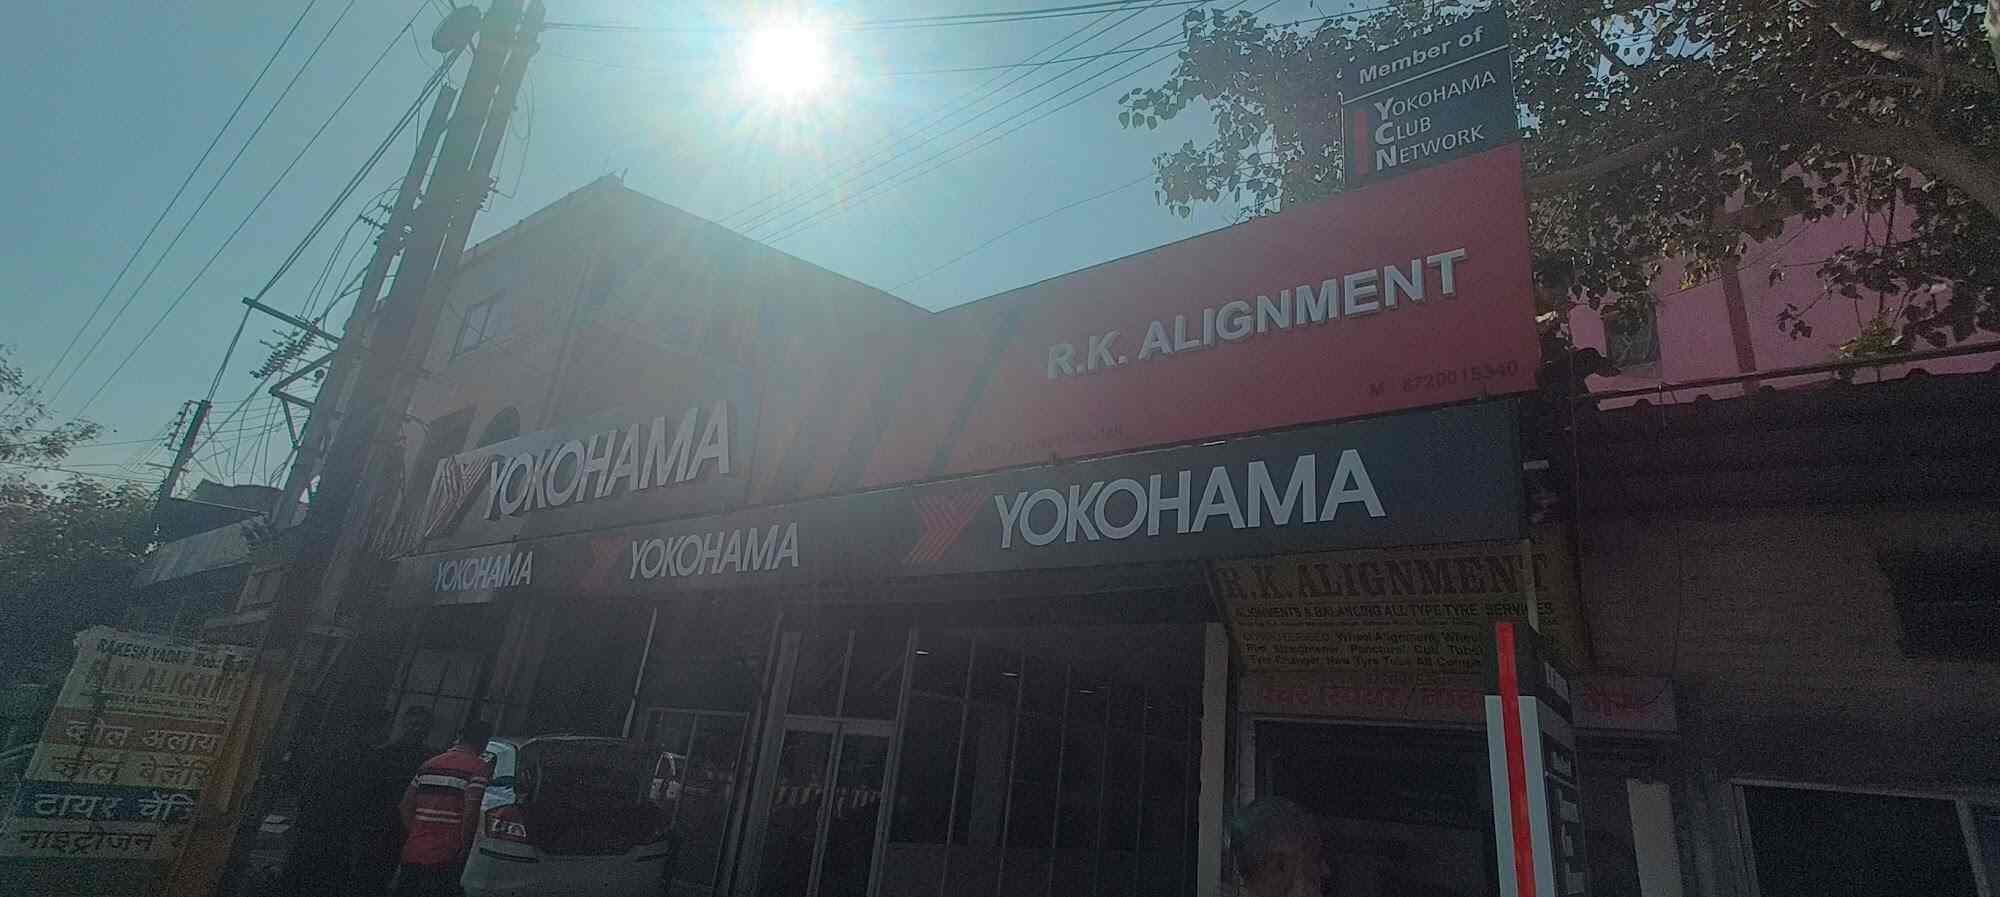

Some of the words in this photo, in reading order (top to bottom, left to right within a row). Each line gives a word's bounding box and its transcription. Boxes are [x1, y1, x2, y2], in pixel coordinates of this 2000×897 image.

[1359, 40, 1451, 84] Member
[1458, 25, 1484, 48] of
[1374, 70, 1497, 121] YOKOHAMA
[1374, 116, 1432, 145] CLUB
[1376, 125, 1485, 170] NETWORK
[1047, 329, 1127, 378] R.K.
[1138, 248, 1466, 359] ALIGNMENT
[484, 400, 729, 520] YOKOHAMA
[994, 448, 1387, 549] YOKOHAMA
[434, 551, 534, 592] YOKOHAMA
[629, 522, 800, 579] YOKOHAMA
[1297, 553, 1549, 597] ALIGNMENT
[1409, 604, 1442, 617] TYPE
[1443, 603, 1479, 617] TYRE
[34, 793, 124, 819] टायर
